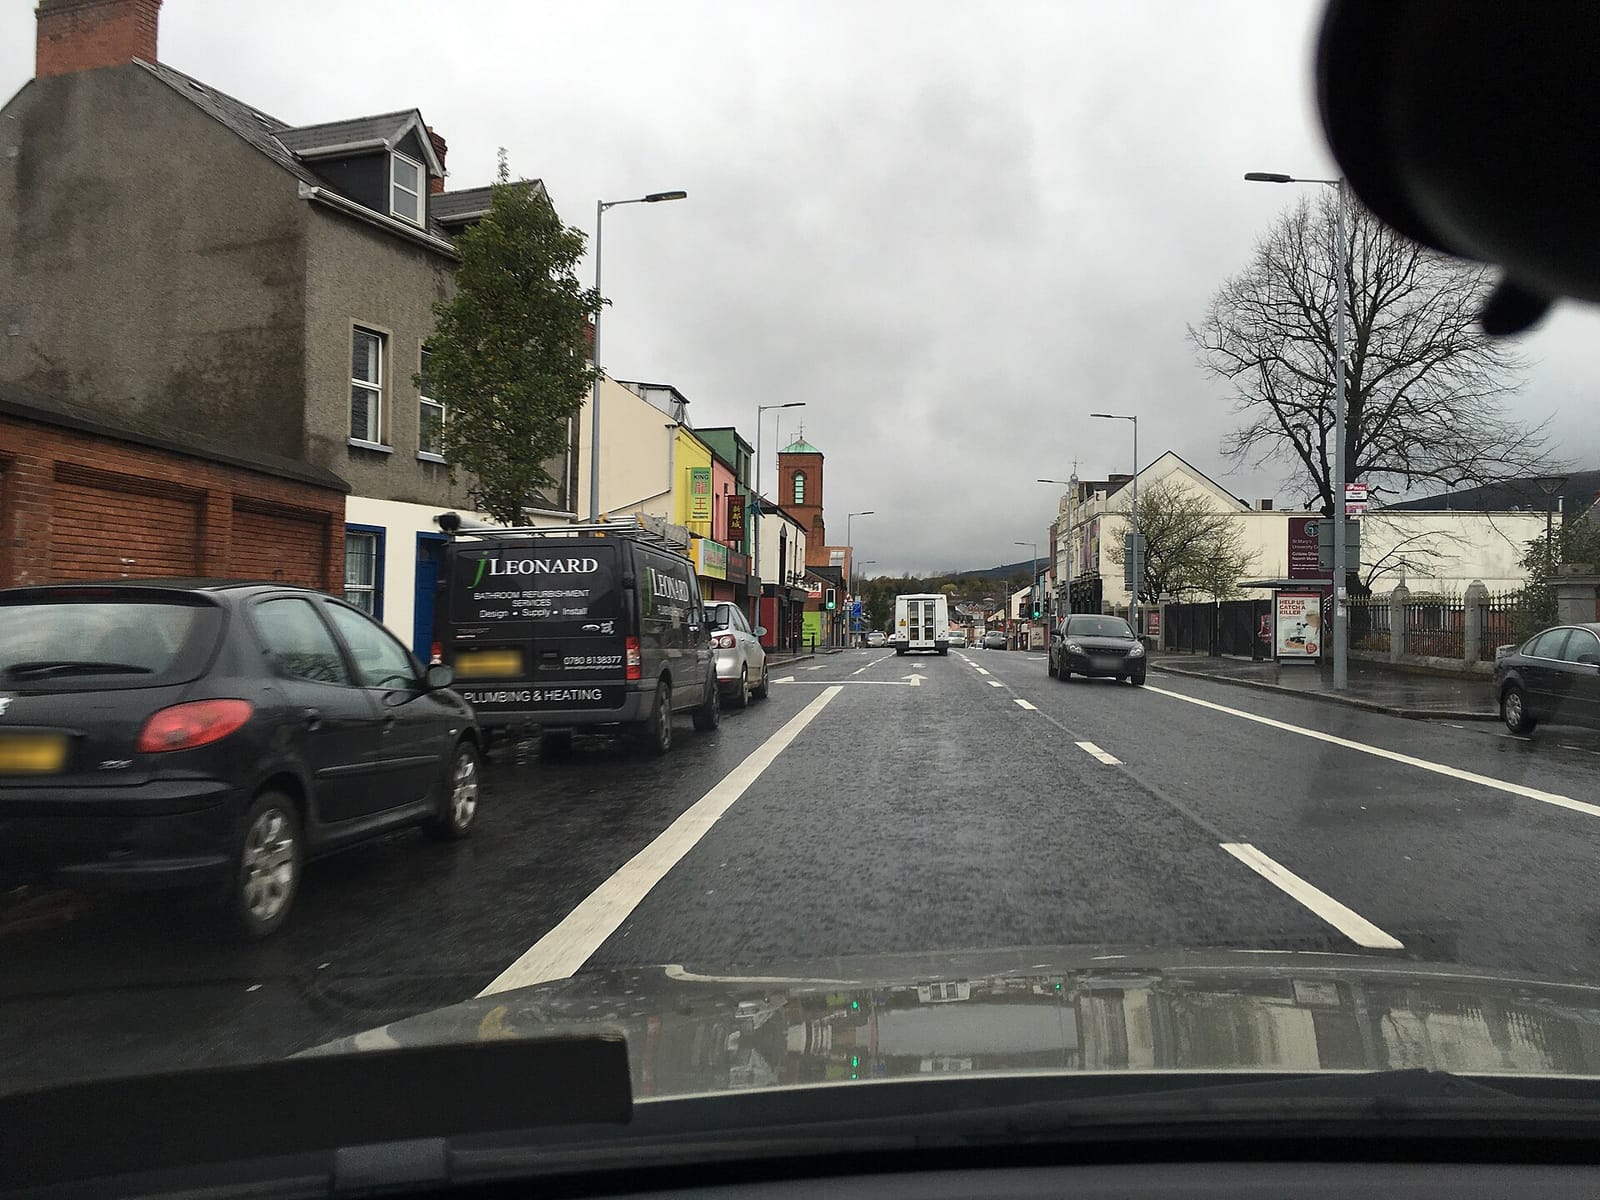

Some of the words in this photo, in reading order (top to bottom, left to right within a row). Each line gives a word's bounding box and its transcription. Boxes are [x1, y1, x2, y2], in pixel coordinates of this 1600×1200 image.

[489, 558, 598, 576] LEONARD
[650, 568, 689, 602] LEONARD
[473, 591, 520, 600] BATHROOM
[521, 589, 591, 598] REFURBISHMENT
[511, 598, 552, 608] SERVICES
[479, 609, 509, 619] Design
[521, 608, 551, 618] Supply
[562, 607, 588, 616] Install
[463, 690, 531, 704] PLUMBING
[532, 691, 543, 702] &
[545, 688, 603, 702] HEATING
